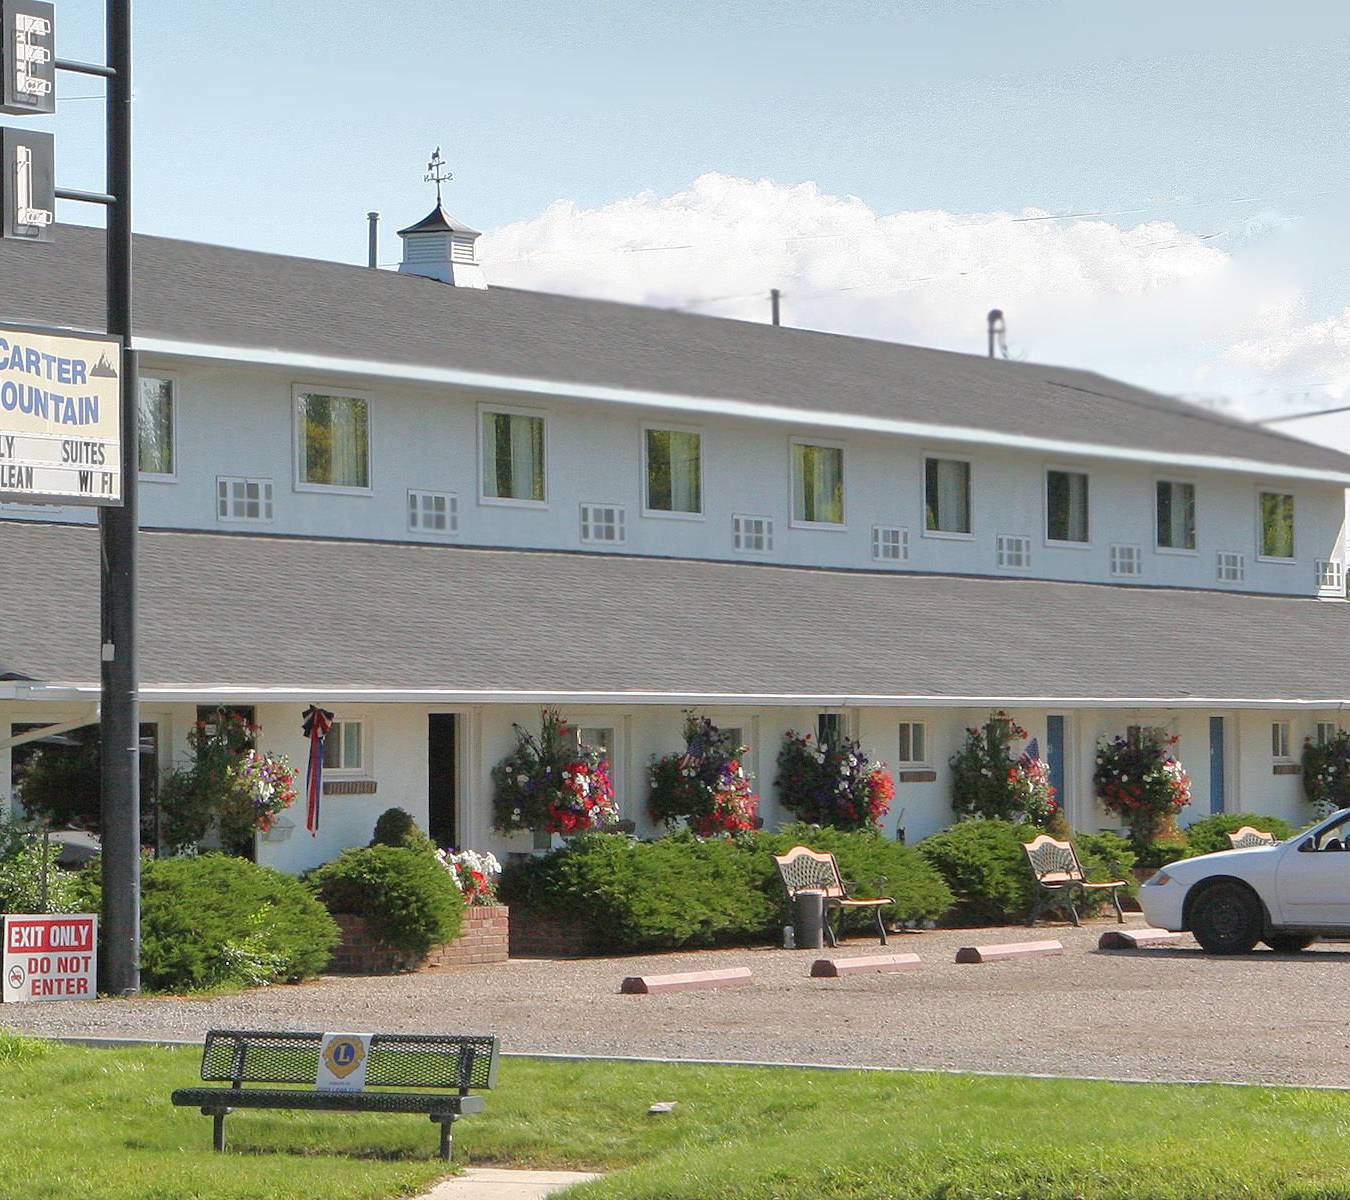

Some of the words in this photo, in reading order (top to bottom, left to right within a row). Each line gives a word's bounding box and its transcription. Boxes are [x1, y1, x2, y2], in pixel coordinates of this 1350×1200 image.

[62, 440, 105, 465] SUITES
[79, 471, 93, 493] WI
[101, 473, 113, 494] FI
[11, 926, 45, 948] EXIT
[50, 925, 90, 946] ONLY
[27, 957, 51, 975] DO
[57, 956, 92, 974] NOT
[31, 977, 88, 996] ENTER
